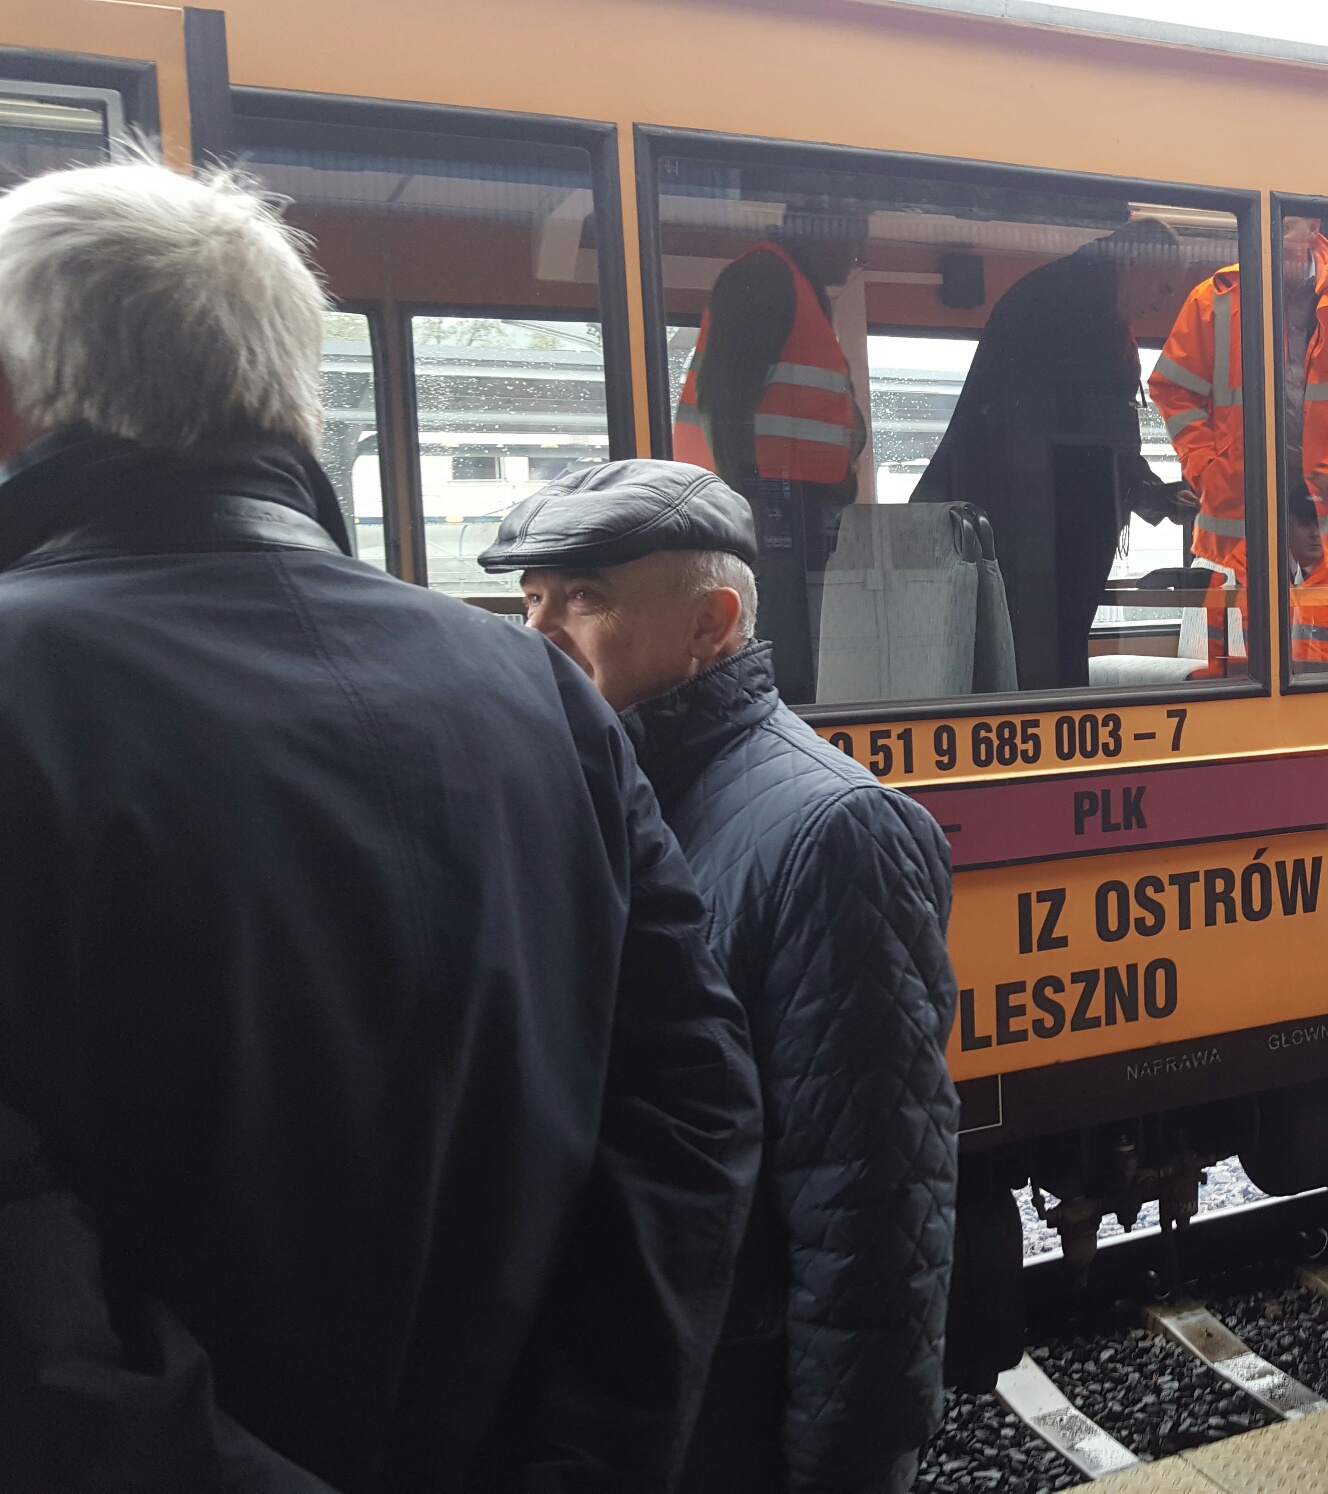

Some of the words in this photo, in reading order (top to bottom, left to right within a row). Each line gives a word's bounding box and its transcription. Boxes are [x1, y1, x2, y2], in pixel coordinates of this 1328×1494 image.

[869, 728, 914, 777] 51
[934, 724, 957, 771] 9
[971, 719, 1042, 768] 685
[1073, 785, 1148, 835] PLK
[1018, 888, 1068, 955] IZ
[1095, 846, 1323, 943] OSTRÓW
[960, 957, 1178, 1052] LESZNO
[1126, 1048, 1221, 1080] NAPRAWA
